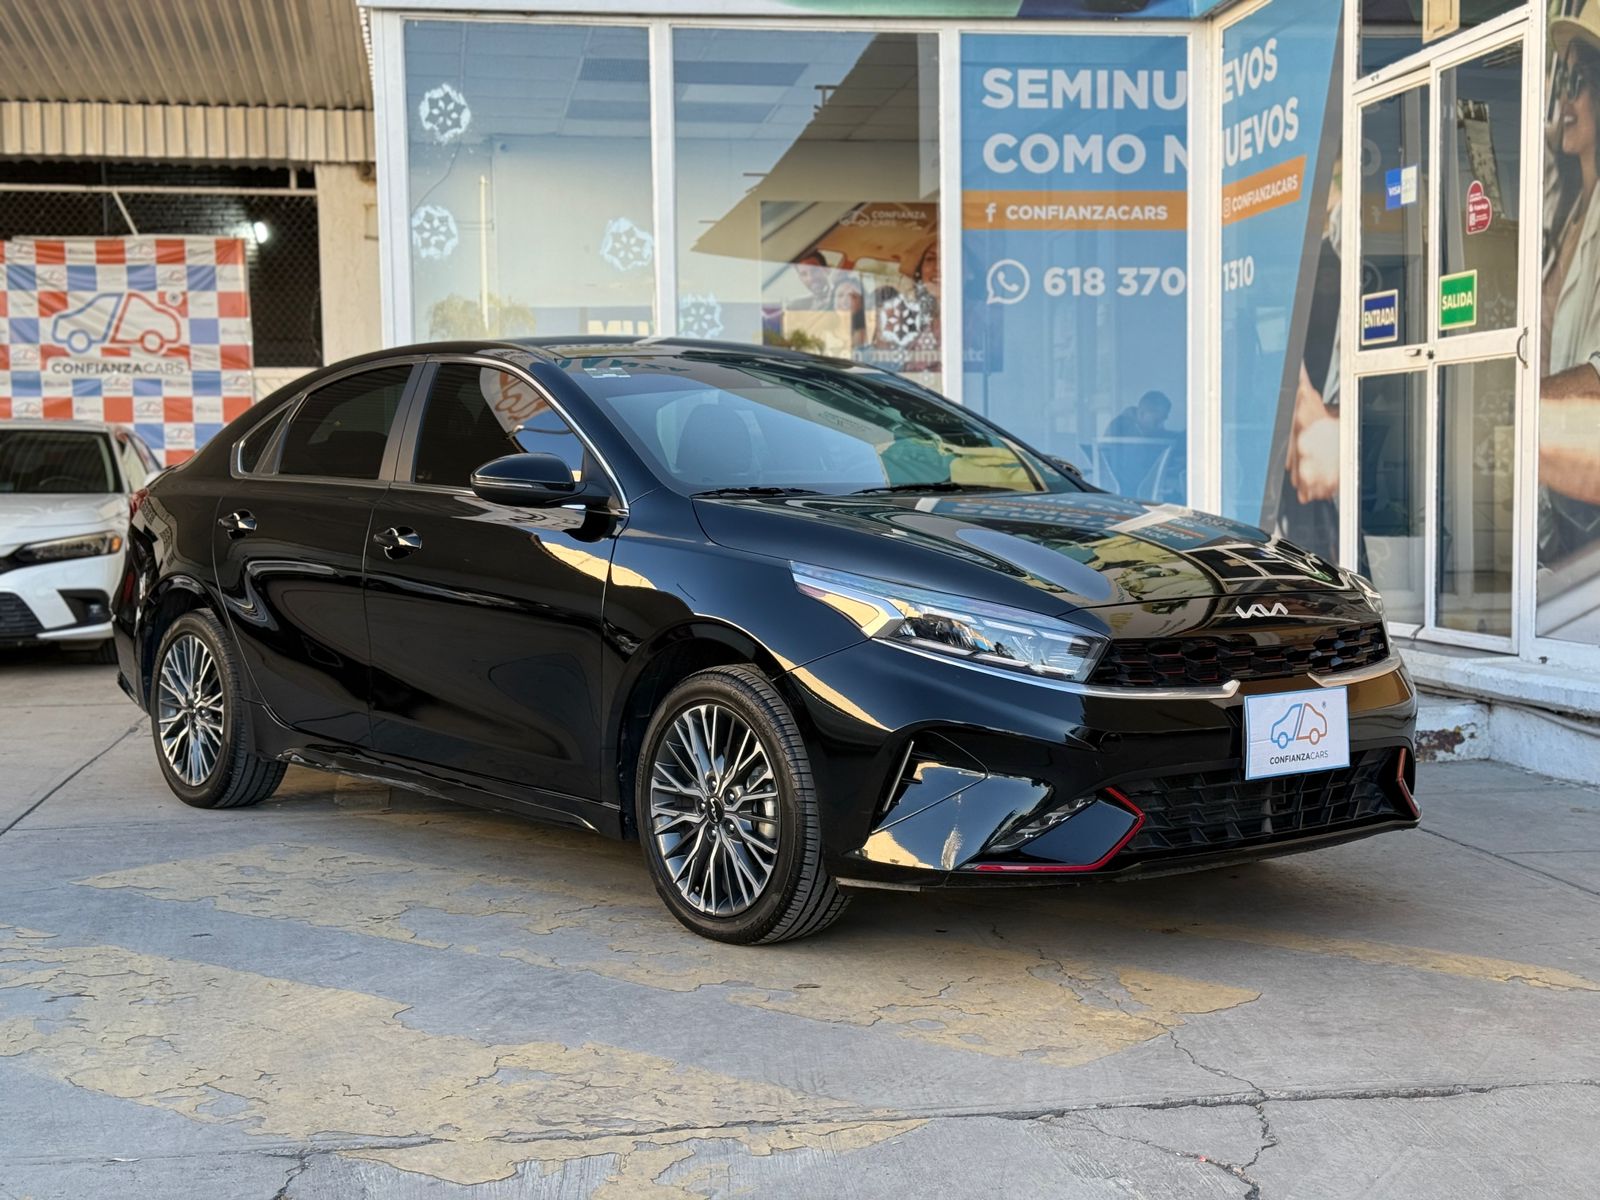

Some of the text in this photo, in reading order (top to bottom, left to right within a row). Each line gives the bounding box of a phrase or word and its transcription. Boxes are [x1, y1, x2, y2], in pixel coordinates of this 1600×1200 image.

[981, 67, 1187, 110] SEMINU
[1222, 96, 1299, 170] UEVOS
[982, 133, 1146, 174] COMO
[1231, 174, 1298, 212] CONFIANZACARS
[871, 210, 927, 219] CONFIANZA
[1006, 205, 1168, 221] CONFIANZACARS
[1043, 267, 1185, 296] 618 370
[1223, 255, 1254, 291] 1310
[1442, 290, 1473, 311] SALIDA
[1364, 307, 1395, 328] ENTRADA
[51, 361, 186, 375] CONFIANZACARS
[1235, 602, 1289, 619] KIA
[1269, 749, 1329, 766] CONFIANZACARS
